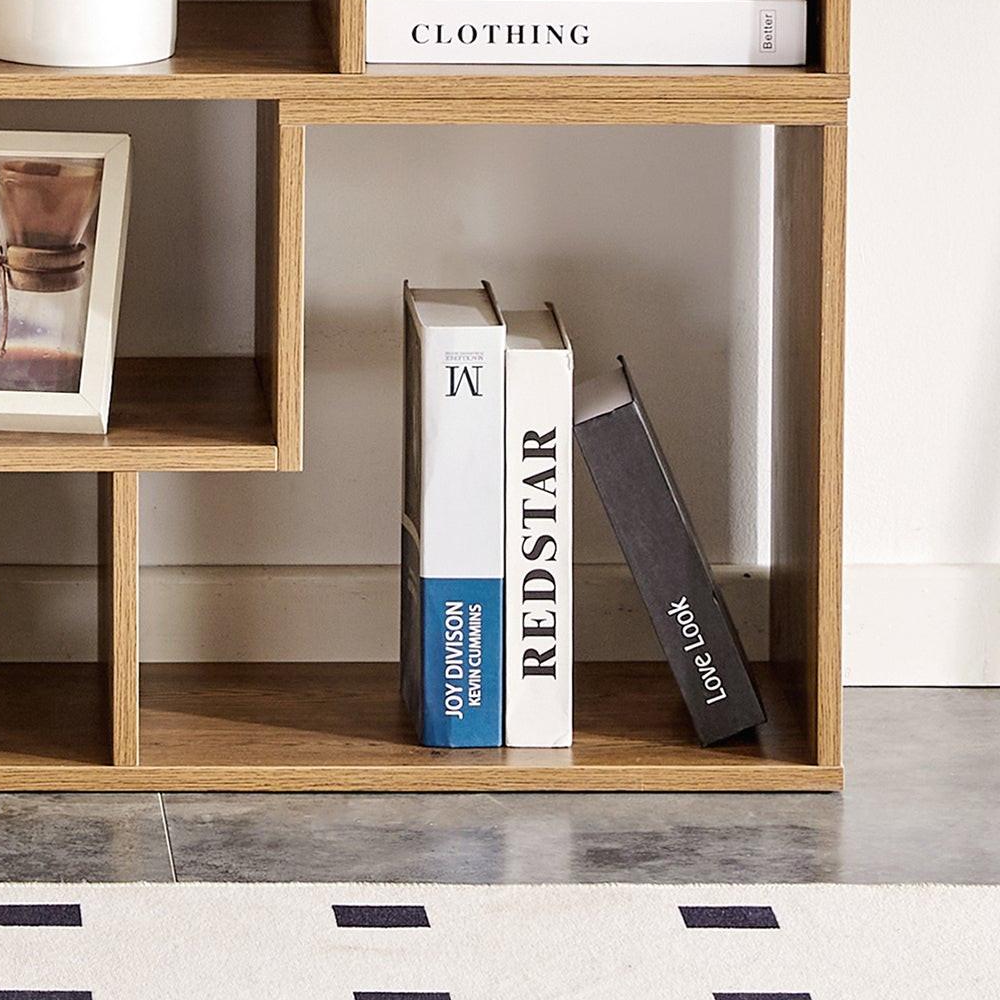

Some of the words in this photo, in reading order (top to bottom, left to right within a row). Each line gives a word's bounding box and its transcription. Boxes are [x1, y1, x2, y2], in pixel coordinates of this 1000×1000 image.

[411, 23, 590, 45] CLOTHING
[763, 13, 773, 50] Better
[445, 366, 483, 397] M
[521, 426, 558, 680] REDSTAR
[445, 602, 463, 679] DIVISON
[468, 604, 481, 667] CUMMINS
[668, 596, 705, 652] Look
[468, 670, 481, 706] KEVIN
[694, 652, 727, 704] Love
[444, 683, 463, 719] JOY
